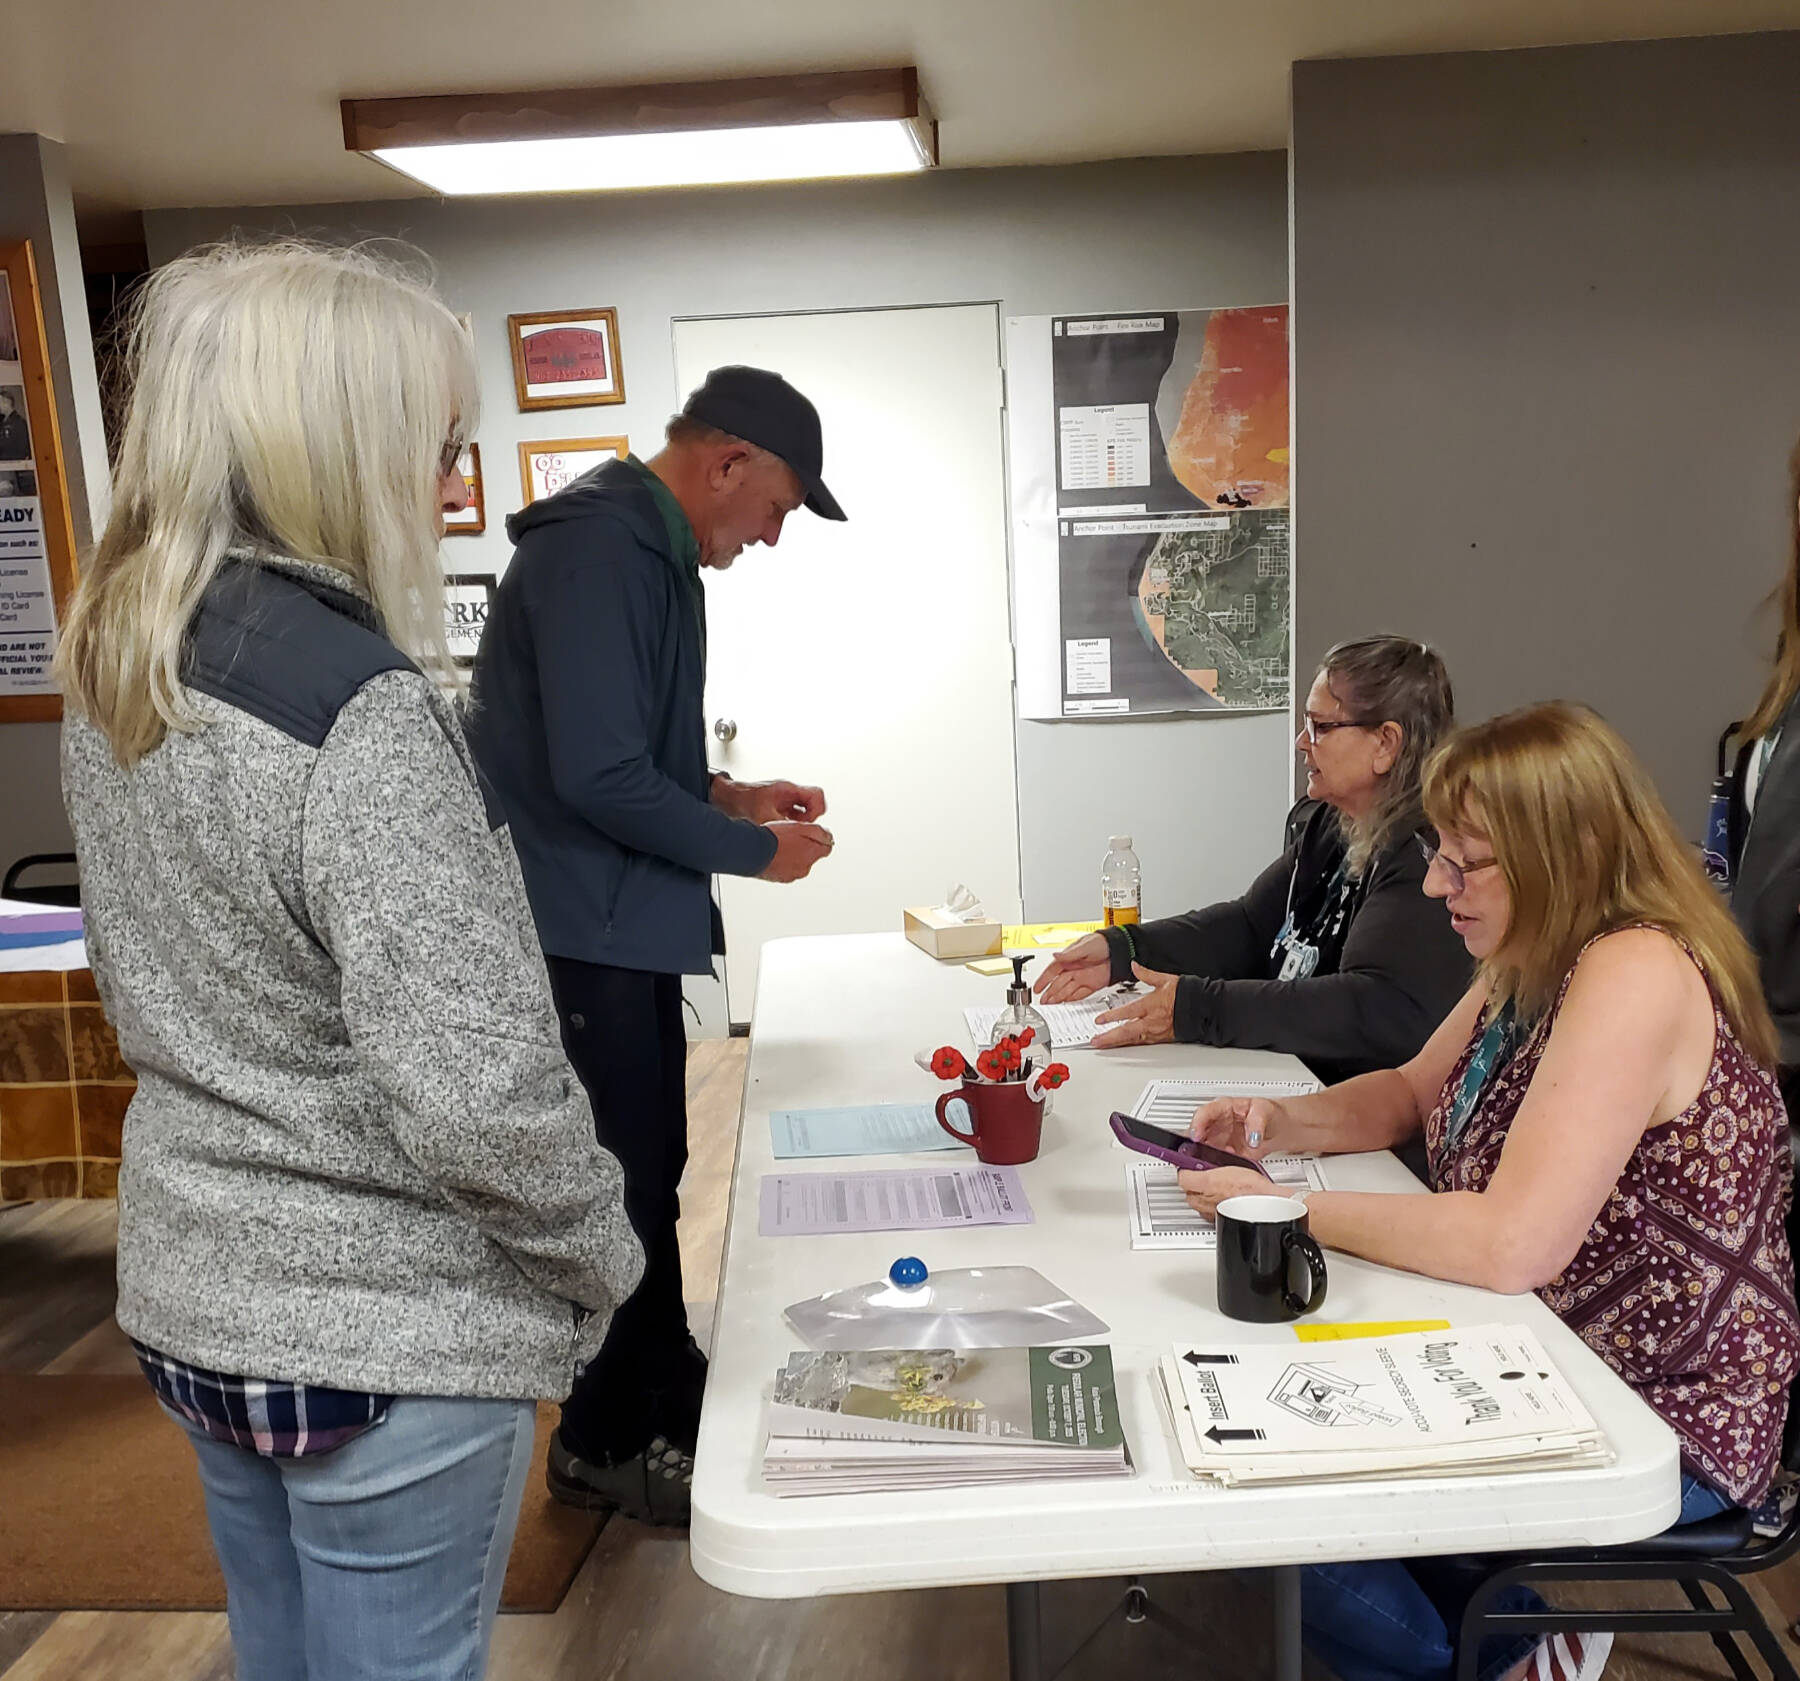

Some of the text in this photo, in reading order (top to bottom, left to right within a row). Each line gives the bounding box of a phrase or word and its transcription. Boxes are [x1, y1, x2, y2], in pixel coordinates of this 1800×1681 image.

[10, 643, 26, 651] ARE
[29, 642, 46, 650] NOT
[1078, 639, 1098, 648] Legend
[1196, 1370, 1225, 1420] Insert Ballot
[1416, 1341, 1501, 1425] Thank You For Voting
